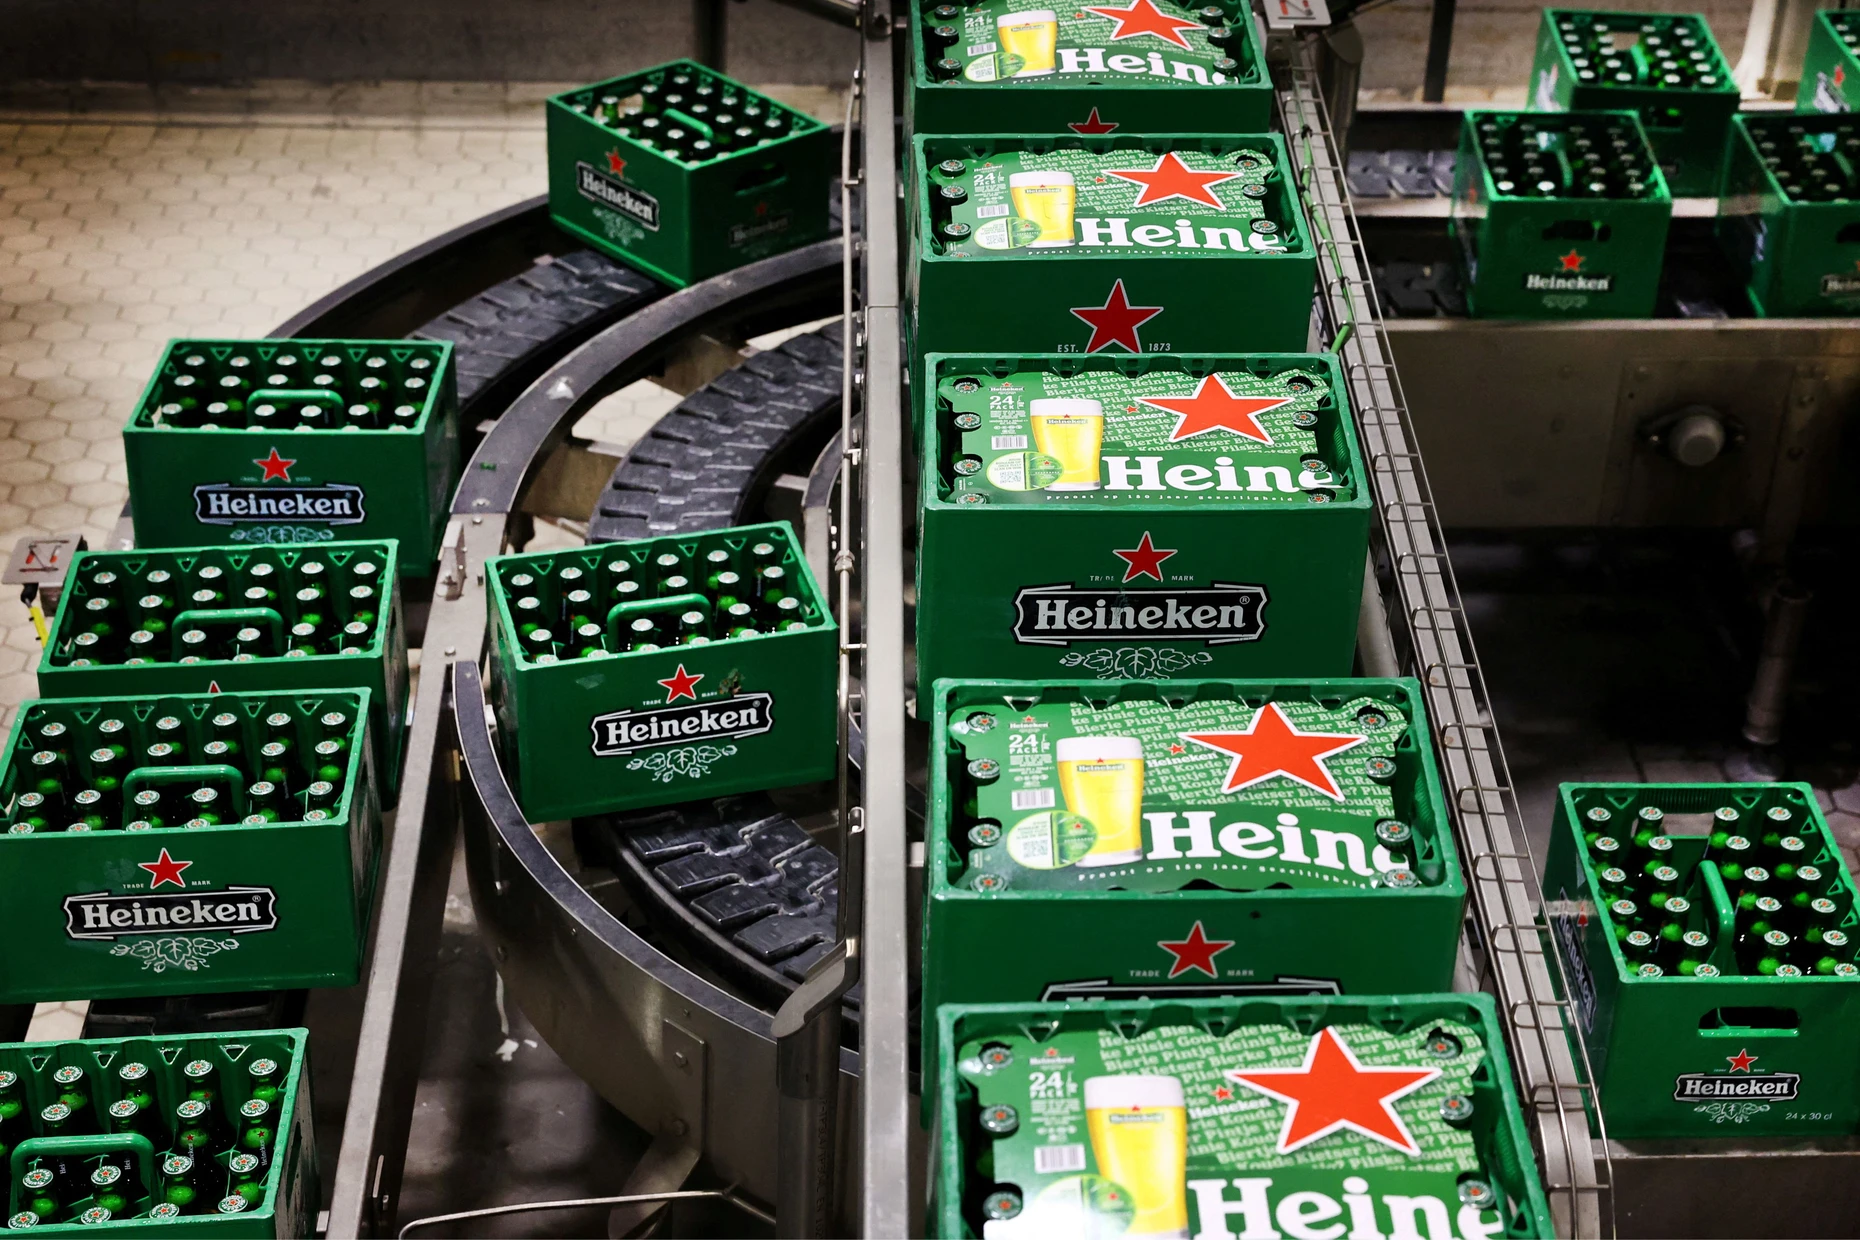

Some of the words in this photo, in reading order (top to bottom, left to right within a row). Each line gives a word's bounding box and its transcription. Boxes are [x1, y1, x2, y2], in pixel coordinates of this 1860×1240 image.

[973, 172, 995, 182] 24
[583, 170, 653, 222] Heineken
[1526, 274, 1609, 291] Heineken
[1057, 344, 1079, 353] EST.
[1149, 343, 1171, 352] 1873
[1087, 384, 1128, 393] Pintje
[989, 395, 1014, 405] 24
[1103, 395, 1135, 404] Pilsi
[1104, 412, 1168, 424] Heineken
[1129, 418, 1172, 428] Koude
[1117, 425, 1157, 436] Pintje
[1134, 429, 1170, 439] Koud
[1182, 440, 1232, 449] Kletser
[208, 493, 352, 515] Heineken
[1034, 599, 1246, 630] Heineken
[606, 708, 759, 746] Heineken
[1124, 716, 1172, 728] Pintje
[1008, 733, 1038, 748] 24
[1143, 730, 1180, 742] Pilsi
[1145, 752, 1220, 768] Heineken
[1174, 760, 1225, 774] Koude
[1160, 770, 1208, 786] Pintje
[1181, 775, 1223, 790] Koud
[1238, 790, 1296, 802] Kletser
[81, 900, 261, 928] Heineken
[1227, 969, 1254, 977] MARK
[1028, 1071, 1064, 1090] 24
[1684, 1077, 1789, 1097] Heineken
[1029, 1089, 1065, 1099] PACK
[1785, 1112, 1798, 1120] 24
[1808, 1112, 1822, 1120] 30
[1823, 1111, 1833, 1120] cl
